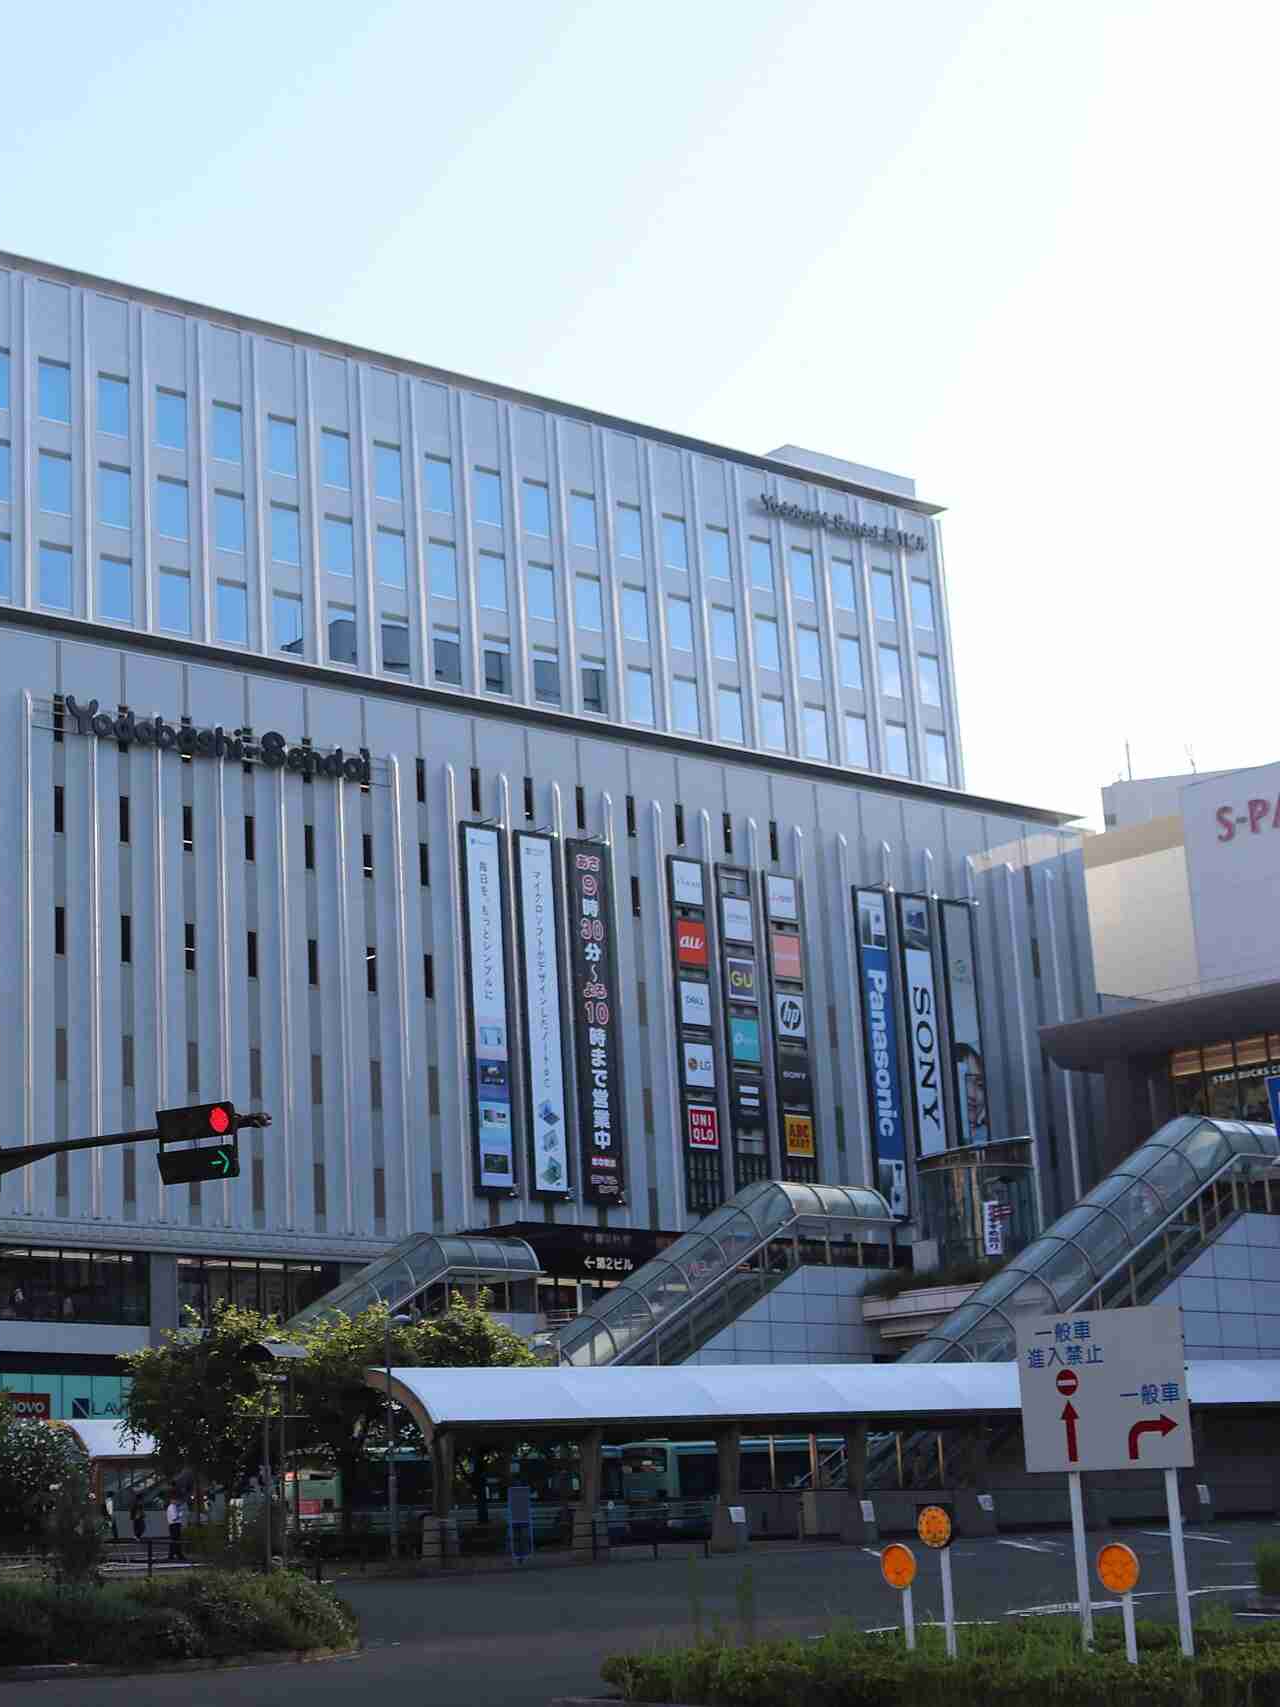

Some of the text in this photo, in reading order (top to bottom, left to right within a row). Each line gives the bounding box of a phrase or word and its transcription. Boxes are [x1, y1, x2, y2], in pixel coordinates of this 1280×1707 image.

[679, 934, 704, 951] au
[730, 970, 753, 988] GU
[867, 967, 899, 1138] Panasonic
[912, 985, 940, 1131] SONY
[691, 1113, 712, 1127] UNI
[693, 1128, 714, 1142] QLO
[1034, 1320, 1092, 1343] 一般車
[1027, 1344, 1105, 1369] 進入禁止
[1119, 1382, 1181, 1405] 一般車
